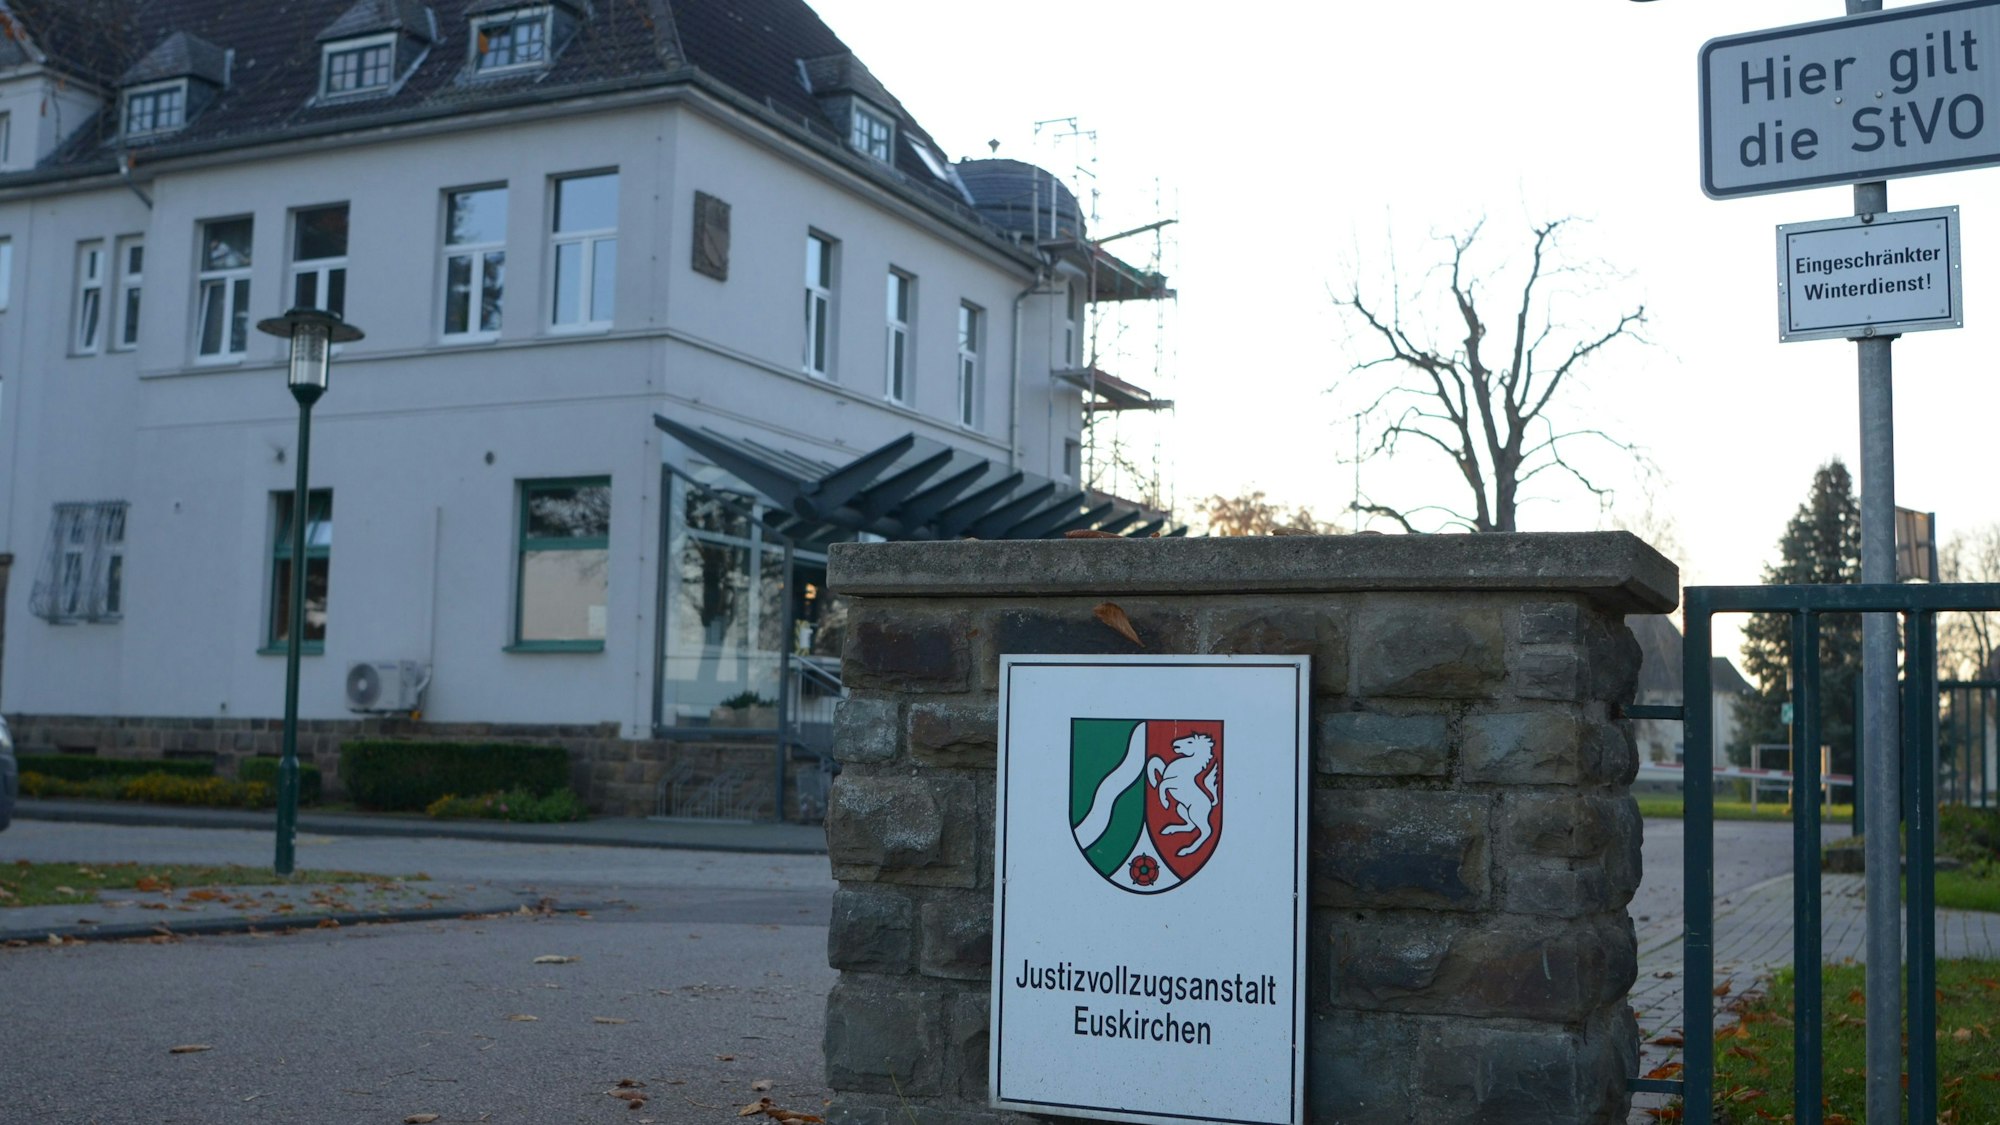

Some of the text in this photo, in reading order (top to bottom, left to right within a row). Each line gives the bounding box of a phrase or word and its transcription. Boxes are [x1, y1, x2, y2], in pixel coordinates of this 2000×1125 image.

[1741, 30, 1978, 104] Hier gilt
[1740, 93, 1984, 167] die StVO
[1795, 246, 1941, 275] Eingeschränkter
[1804, 273, 1931, 301] Winterdienst!
[1015, 959, 1277, 1006] Justizvollzugsanstalt
[1074, 1005, 1212, 1045] Euskirchen
